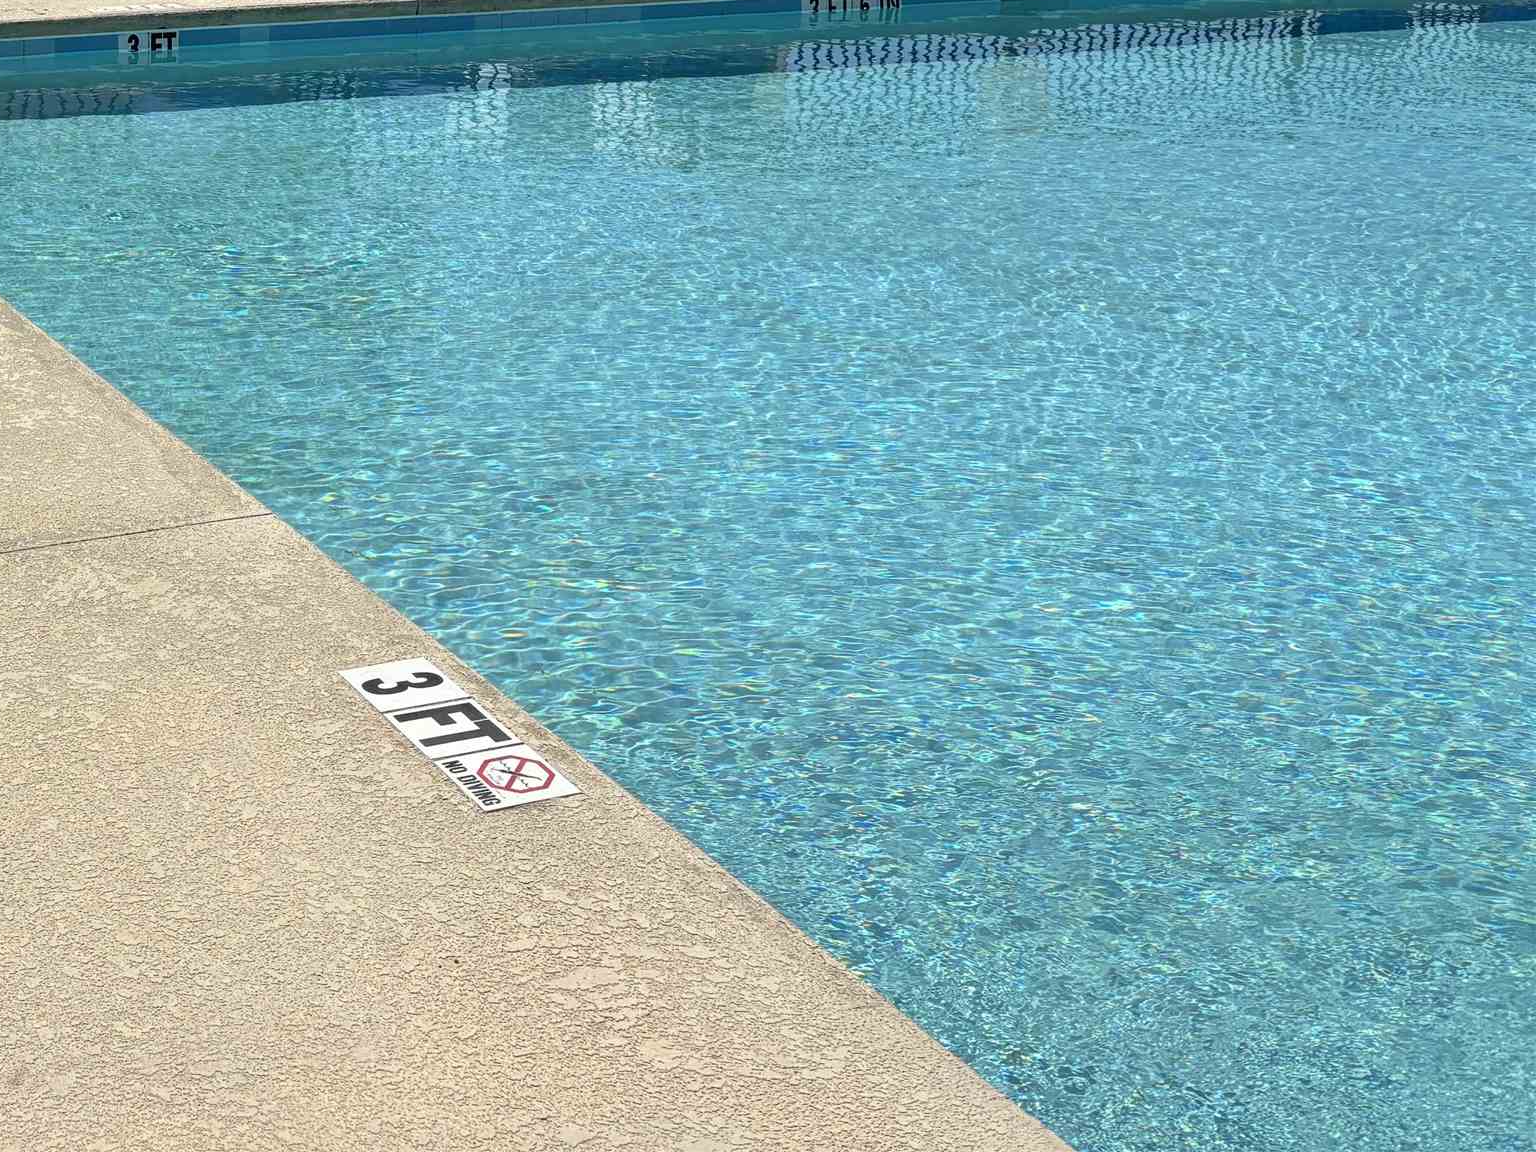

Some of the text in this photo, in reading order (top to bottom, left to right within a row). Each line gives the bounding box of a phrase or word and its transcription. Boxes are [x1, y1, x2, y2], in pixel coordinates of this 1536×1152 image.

[127, 31, 177, 52] 3 FT
[361, 671, 513, 748] 3 FT
[441, 760, 502, 808] NO DIVING
